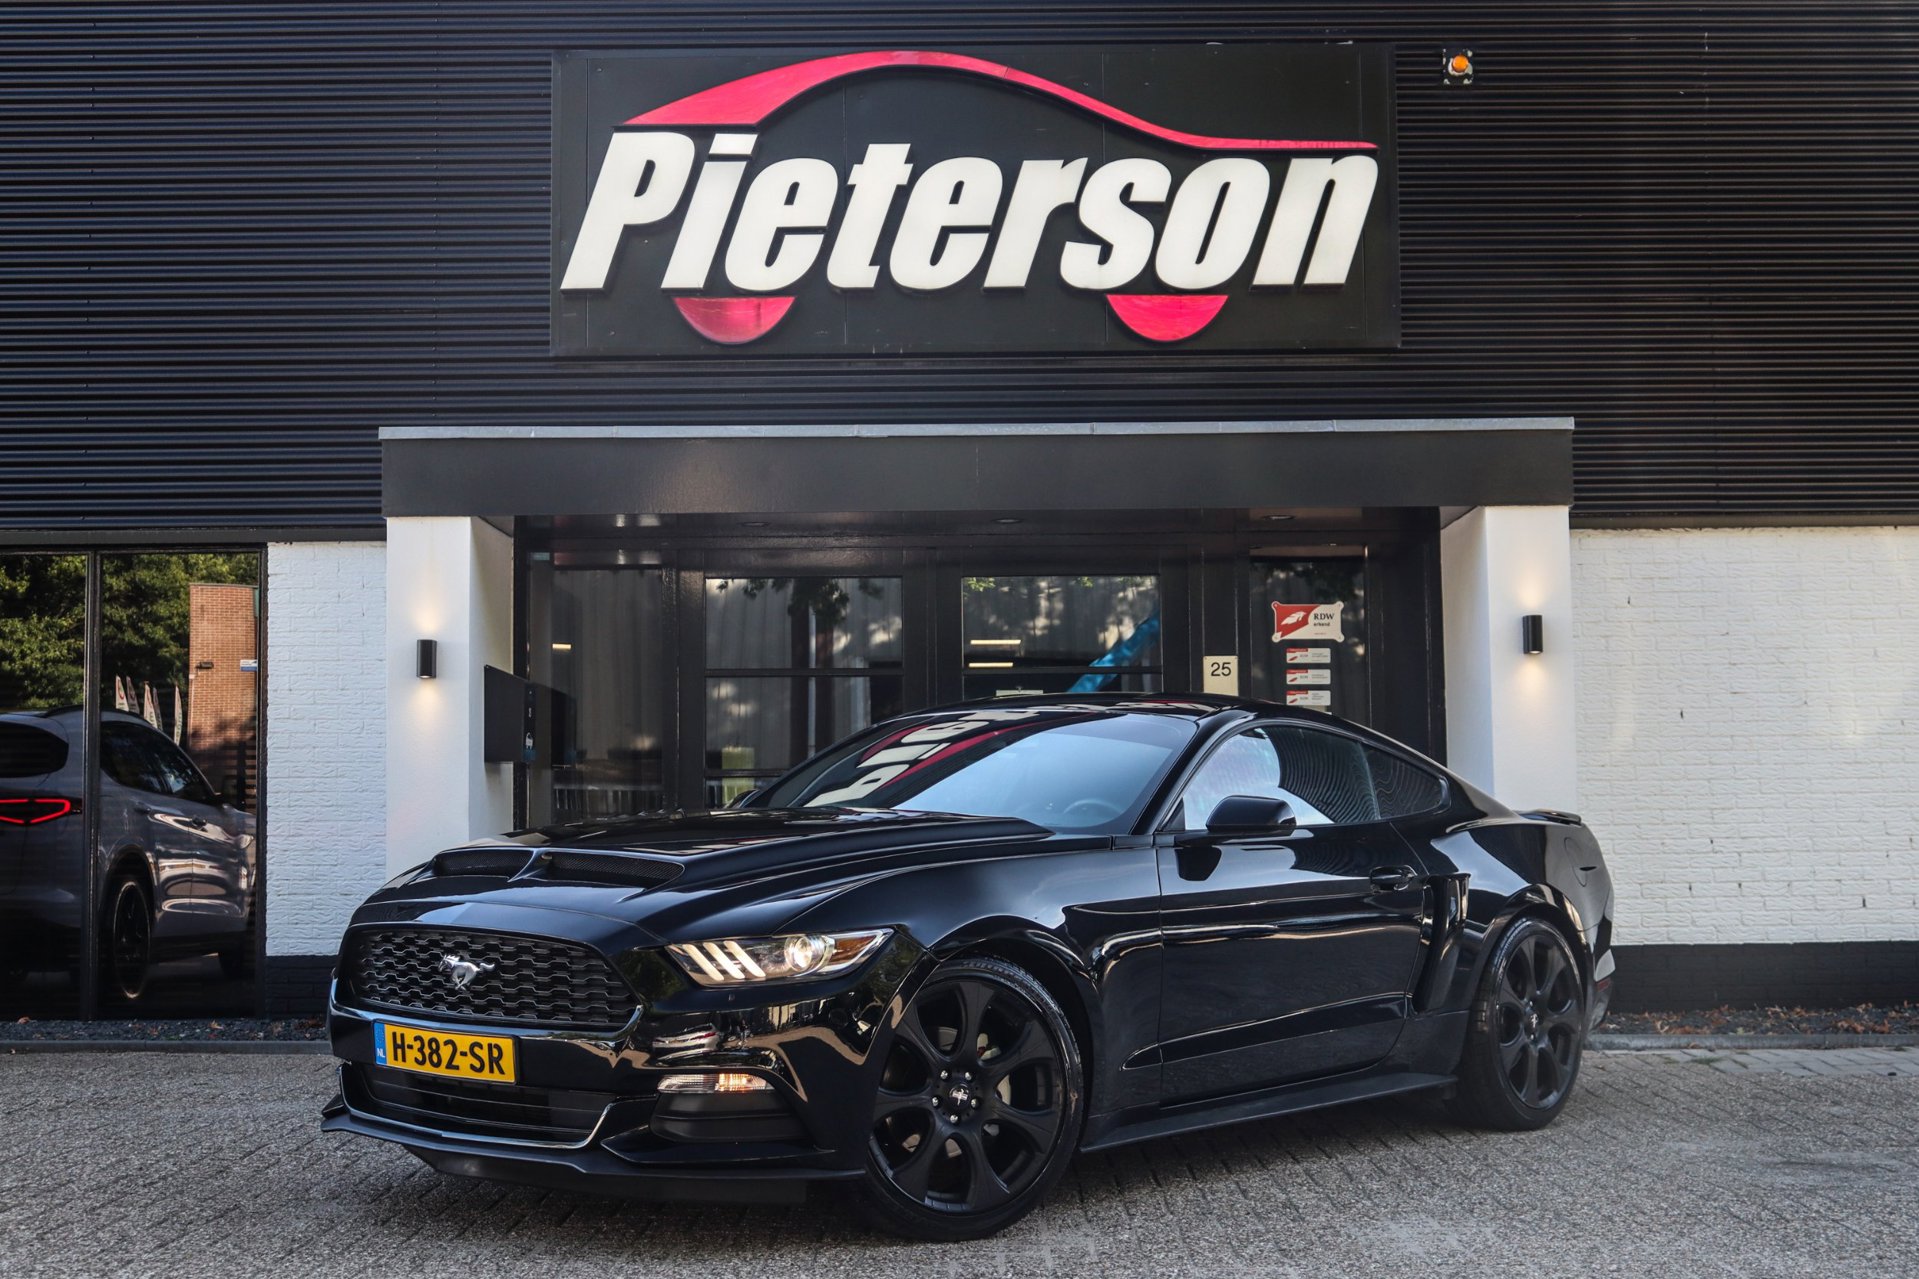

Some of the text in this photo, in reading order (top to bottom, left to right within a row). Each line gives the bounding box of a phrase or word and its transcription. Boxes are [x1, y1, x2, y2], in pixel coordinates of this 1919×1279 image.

[560, 131, 1379, 291] Pieterson
[1210, 661, 1232, 677] 25
[376, 1047, 386, 1058] NL
[392, 1031, 505, 1075] H-382-SR
